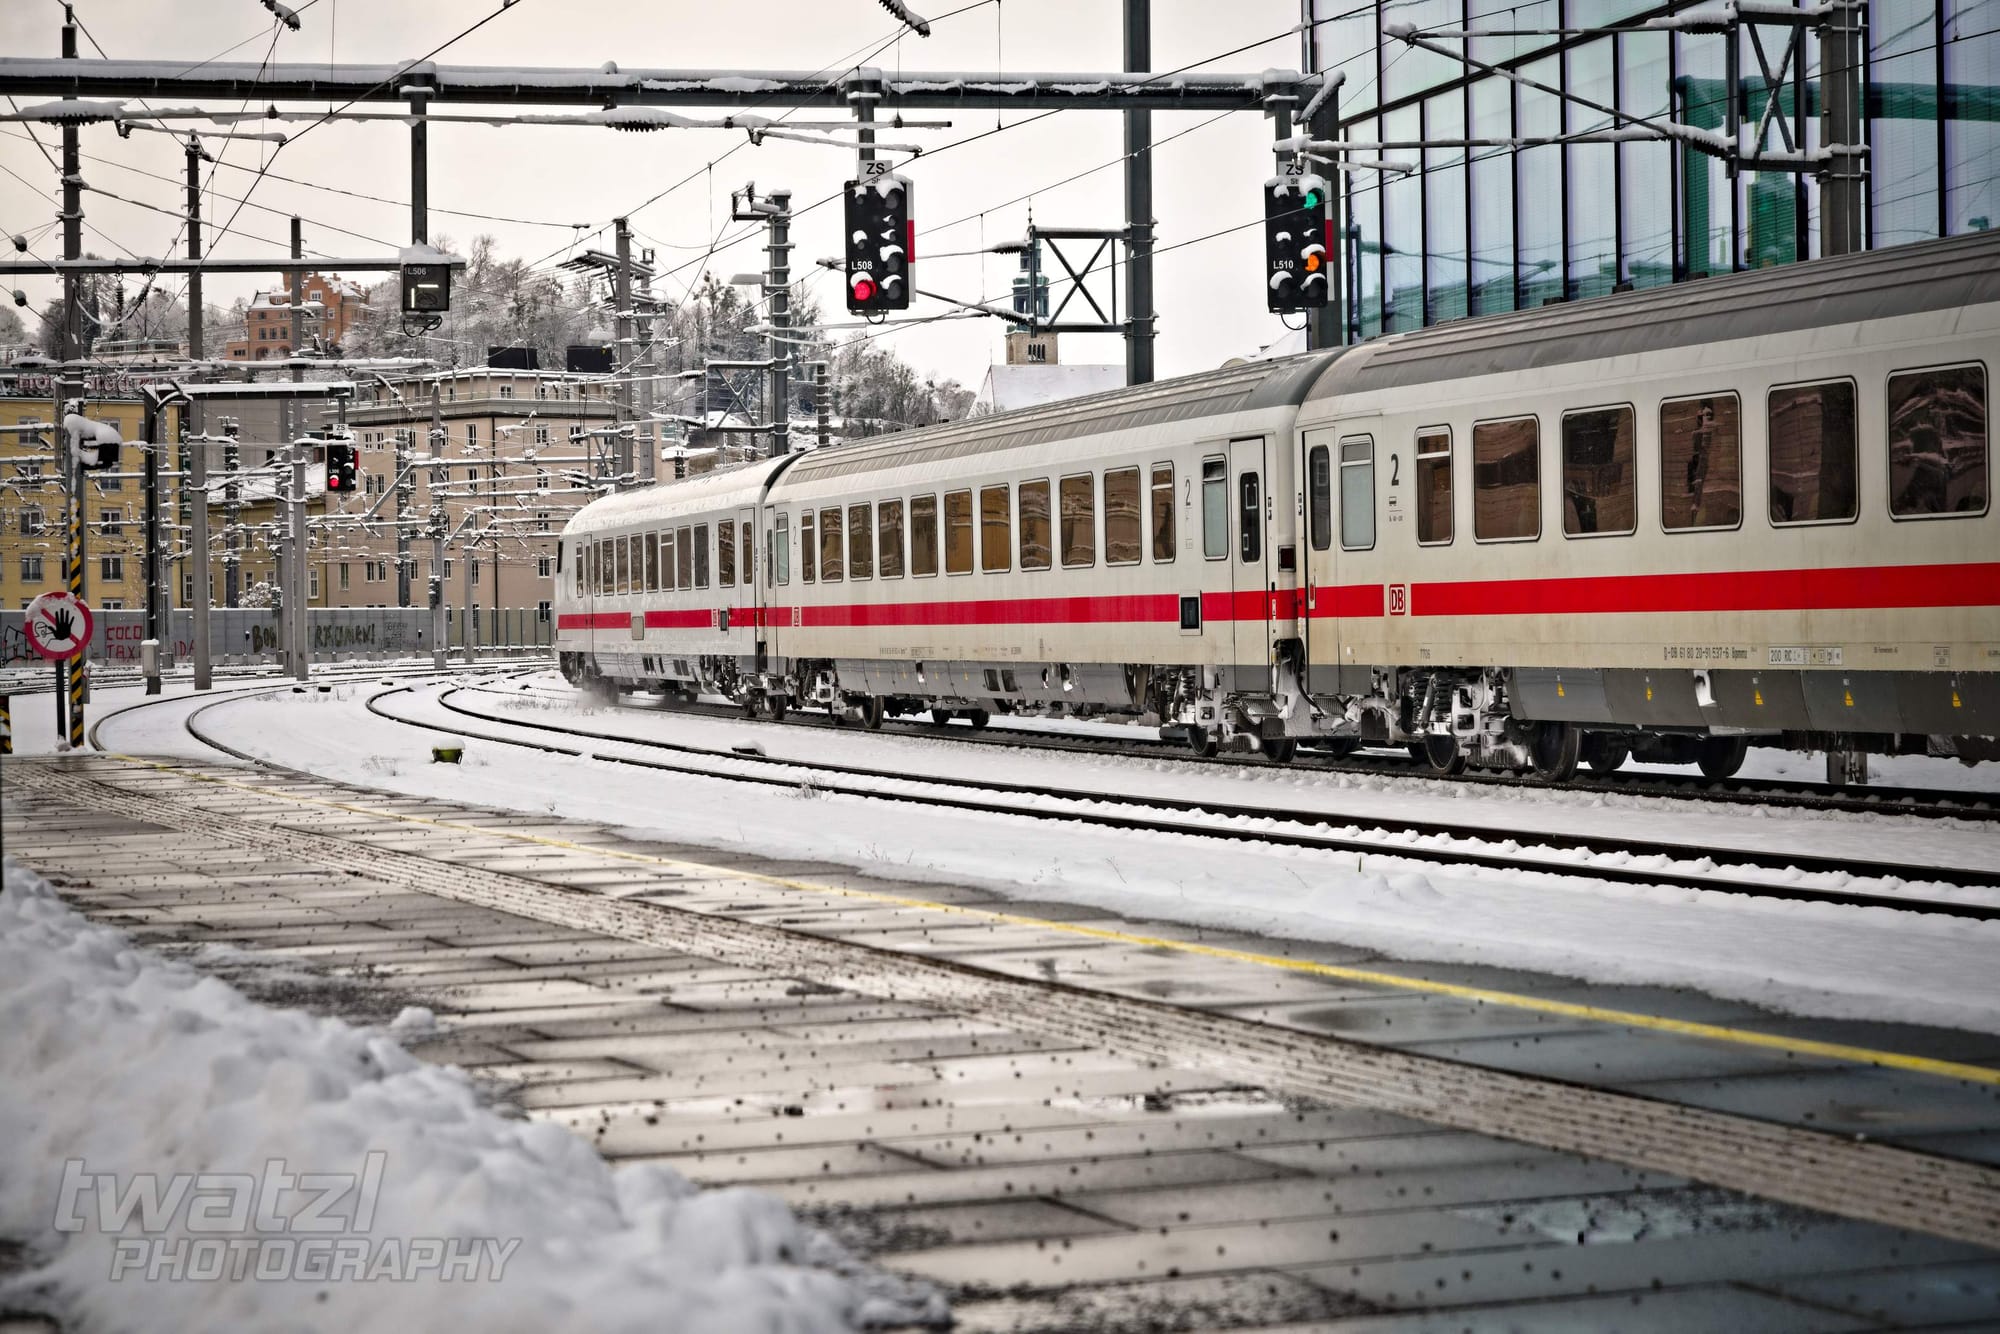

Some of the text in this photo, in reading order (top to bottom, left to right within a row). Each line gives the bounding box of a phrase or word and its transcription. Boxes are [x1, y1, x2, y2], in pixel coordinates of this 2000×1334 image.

[866, 162, 885, 175] ZS
[1286, 163, 1304, 176] ZS
[851, 260, 873, 270] L508
[1273, 259, 1294, 269] L510
[1390, 453, 1400, 486] 2
[1185, 478, 1191, 506] 2
[1390, 588, 1405, 612] DB
